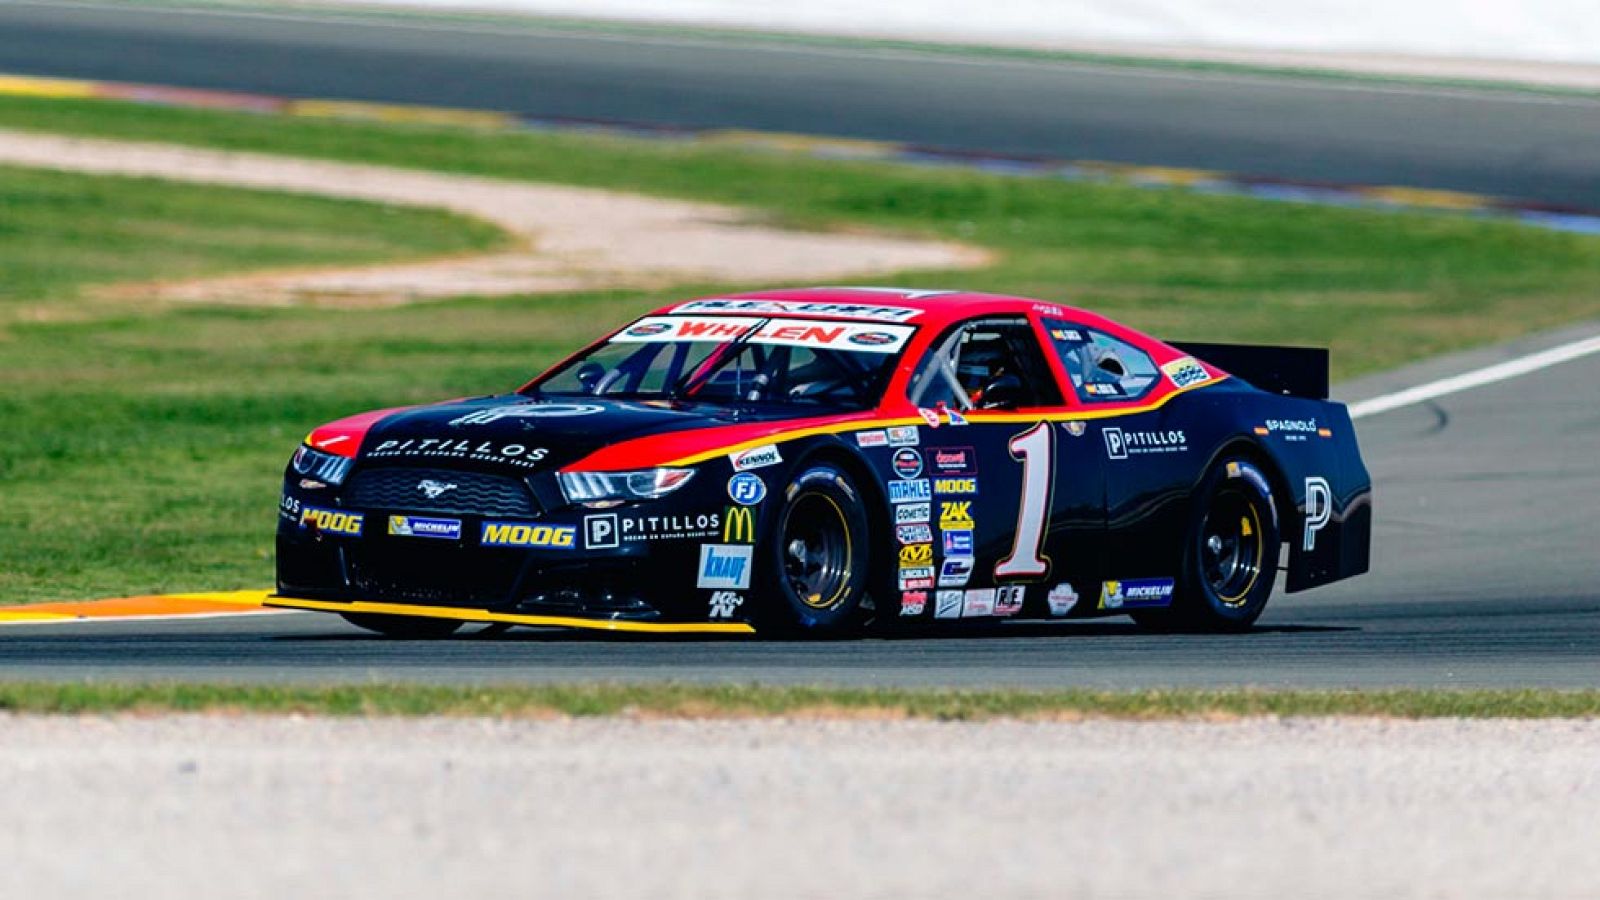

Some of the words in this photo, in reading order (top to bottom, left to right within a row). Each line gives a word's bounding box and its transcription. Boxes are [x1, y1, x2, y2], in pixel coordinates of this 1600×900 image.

[1125, 430, 1186, 446] PITILLOS
[376, 439, 549, 460] PITILLOS
[934, 478, 976, 494] MOOG
[995, 420, 1053, 580] 1
[940, 501, 972, 521] ZAK
[623, 514, 720, 533] PITILLOS
[482, 524, 576, 546] MOOG
[1126, 585, 1174, 598] MICHELIN
